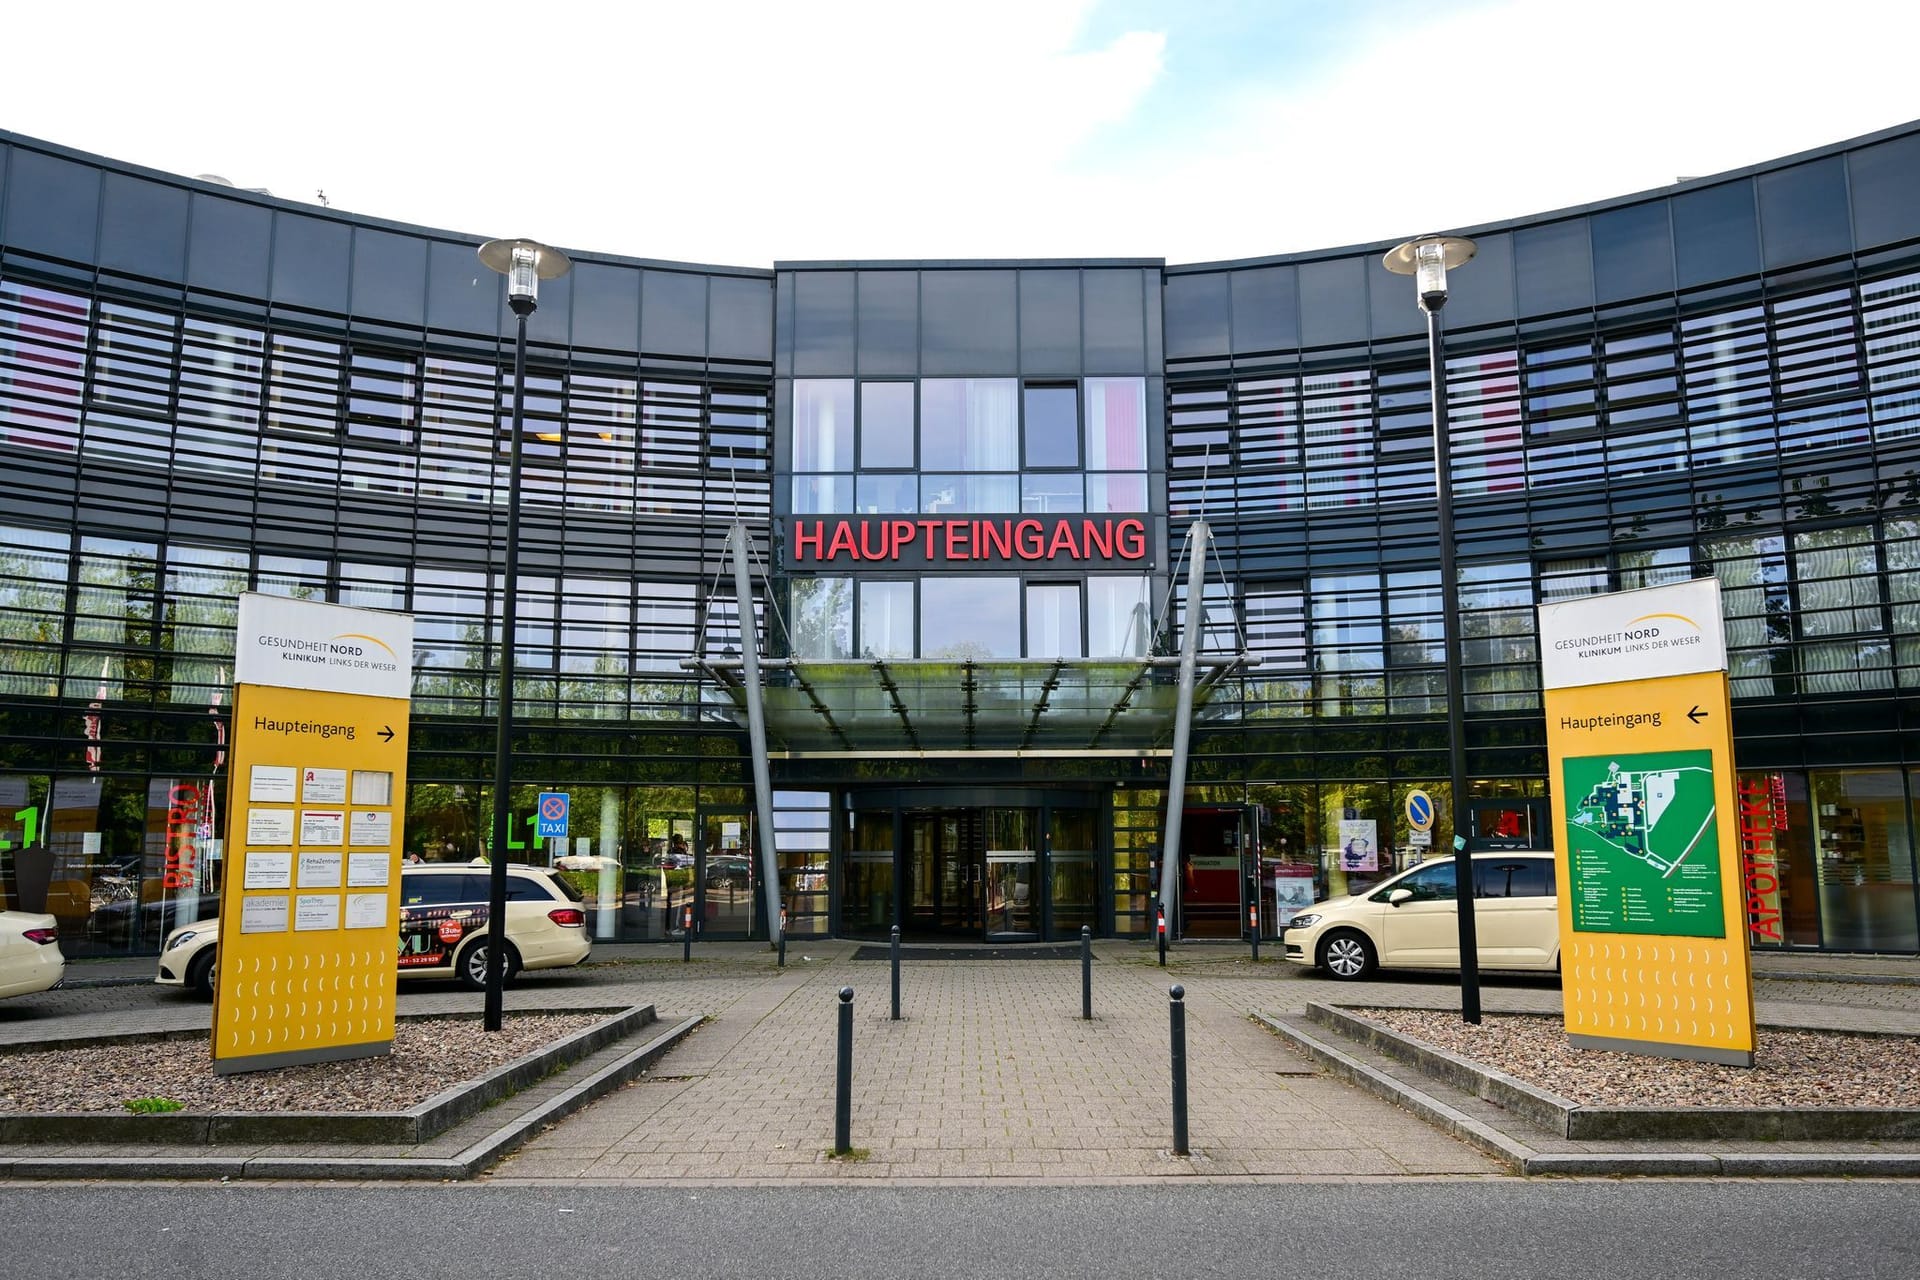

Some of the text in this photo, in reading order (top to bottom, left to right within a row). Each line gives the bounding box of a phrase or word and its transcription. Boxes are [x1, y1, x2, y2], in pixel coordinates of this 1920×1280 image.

[795, 519, 1145, 560] HAUPTEINGANG
[258, 635, 363, 656] GESUNDHEIT NORD
[1555, 627, 1660, 650] GESUNDHEIT NORD
[1578, 635, 1701, 658] KLINIKUM LINKS DER WESER
[282, 651, 397, 672] KLINIKUM LINKS DER WESER
[255, 716, 356, 740] Haupteingang
[1561, 712, 1662, 731] Haupteingang
[163, 784, 200, 888] BISTRO
[541, 823, 565, 833] TAXI
[1737, 777, 1783, 941] APOTHEKE
